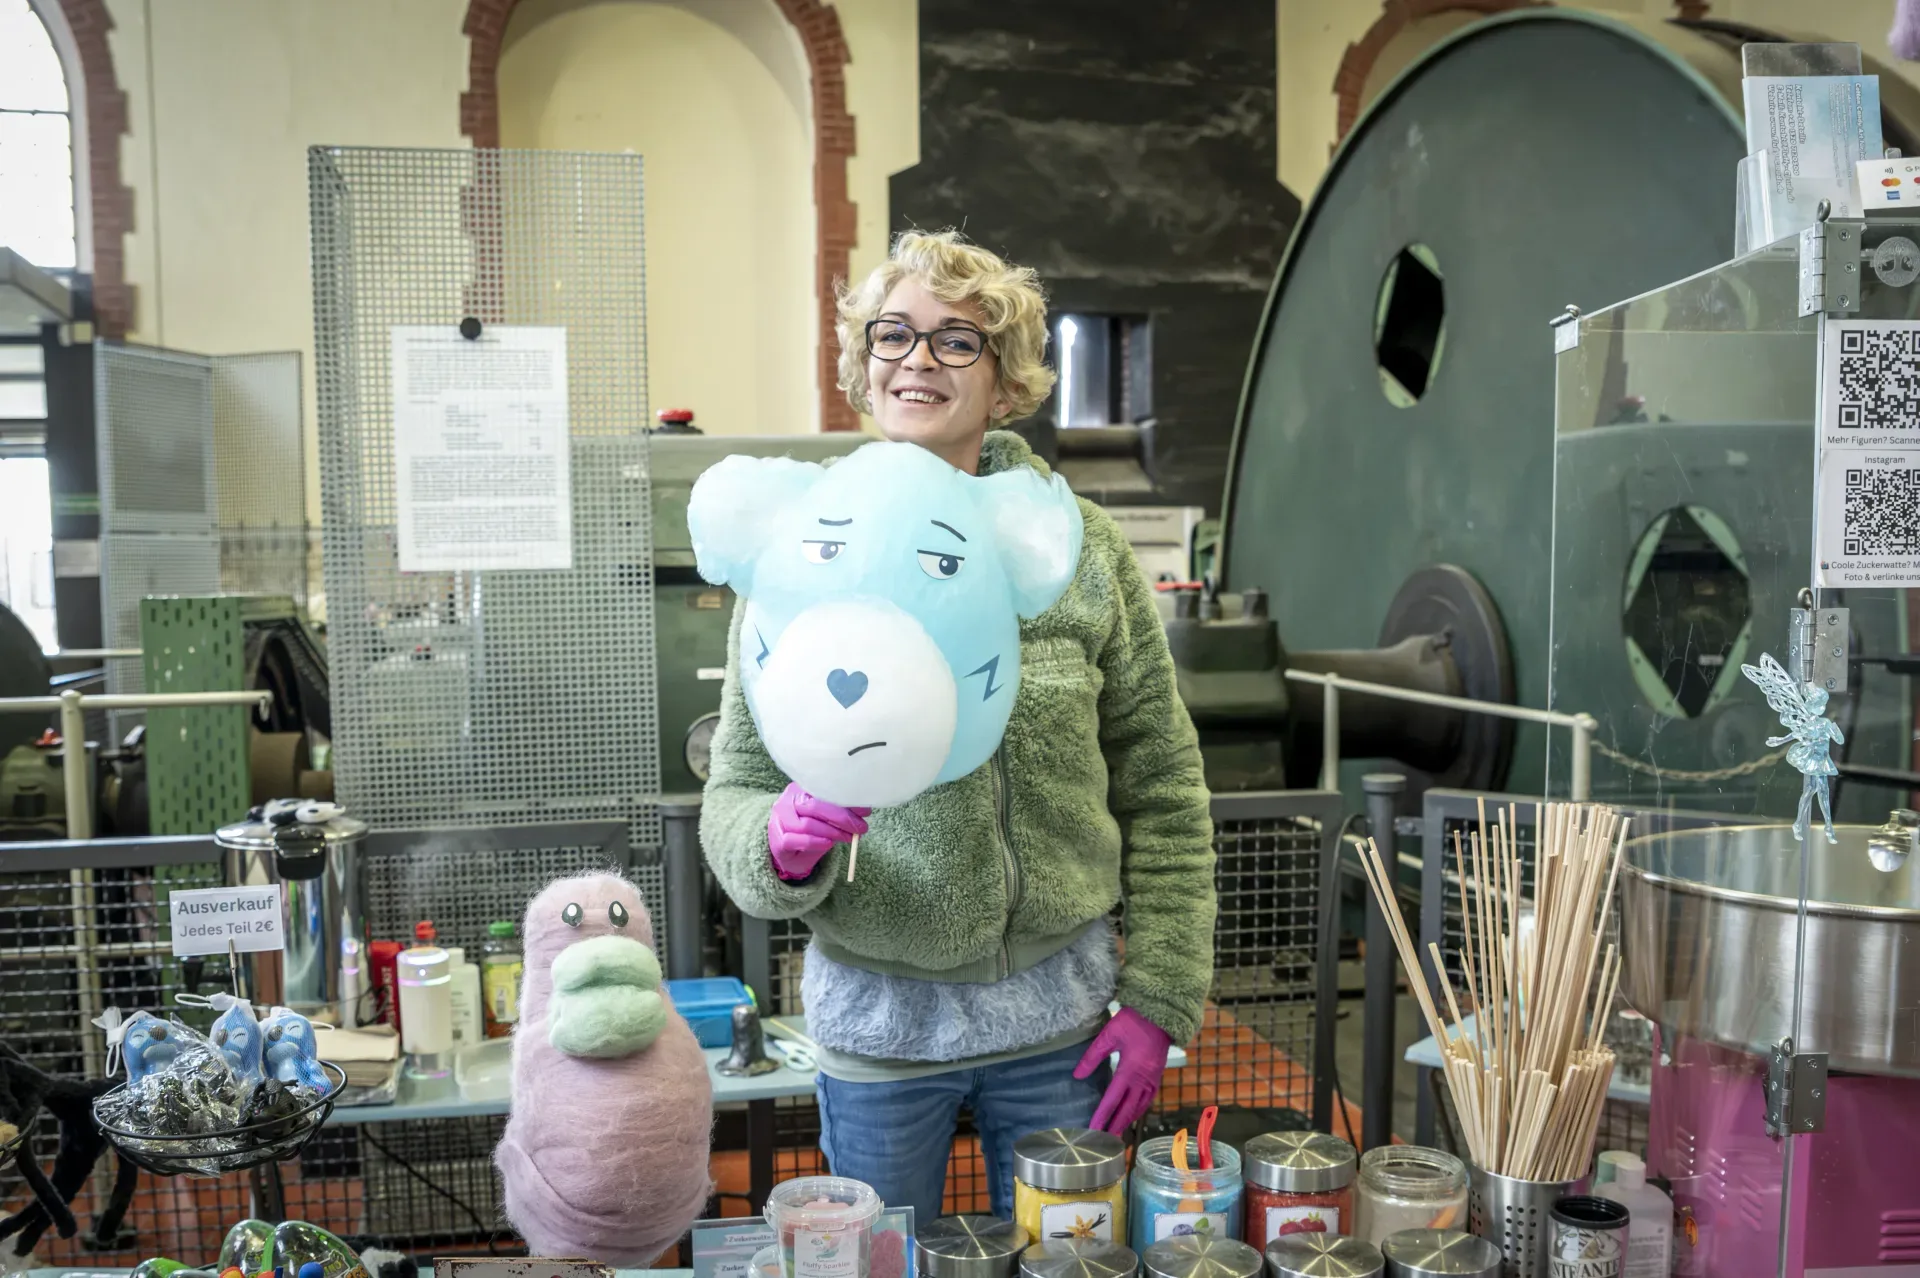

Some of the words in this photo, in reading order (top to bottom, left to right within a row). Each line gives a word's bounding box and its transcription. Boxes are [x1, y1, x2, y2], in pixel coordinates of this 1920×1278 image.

[1827, 436, 1849, 444] Mehr
[1851, 436, 1887, 446] Figuren?
[1864, 456, 1906, 465] Instagram
[1831, 561, 1855, 569] Coole
[1856, 561, 1911, 569] Zuckerwatte?
[177, 895, 274, 915] Ausverkauf
[180, 924, 223, 937] Jedes
[226, 921, 252, 935] Teil
[255, 920, 274, 933] 2€
[721, 1264, 745, 1272] Zucker
[802, 1261, 822, 1269] Fluffy
